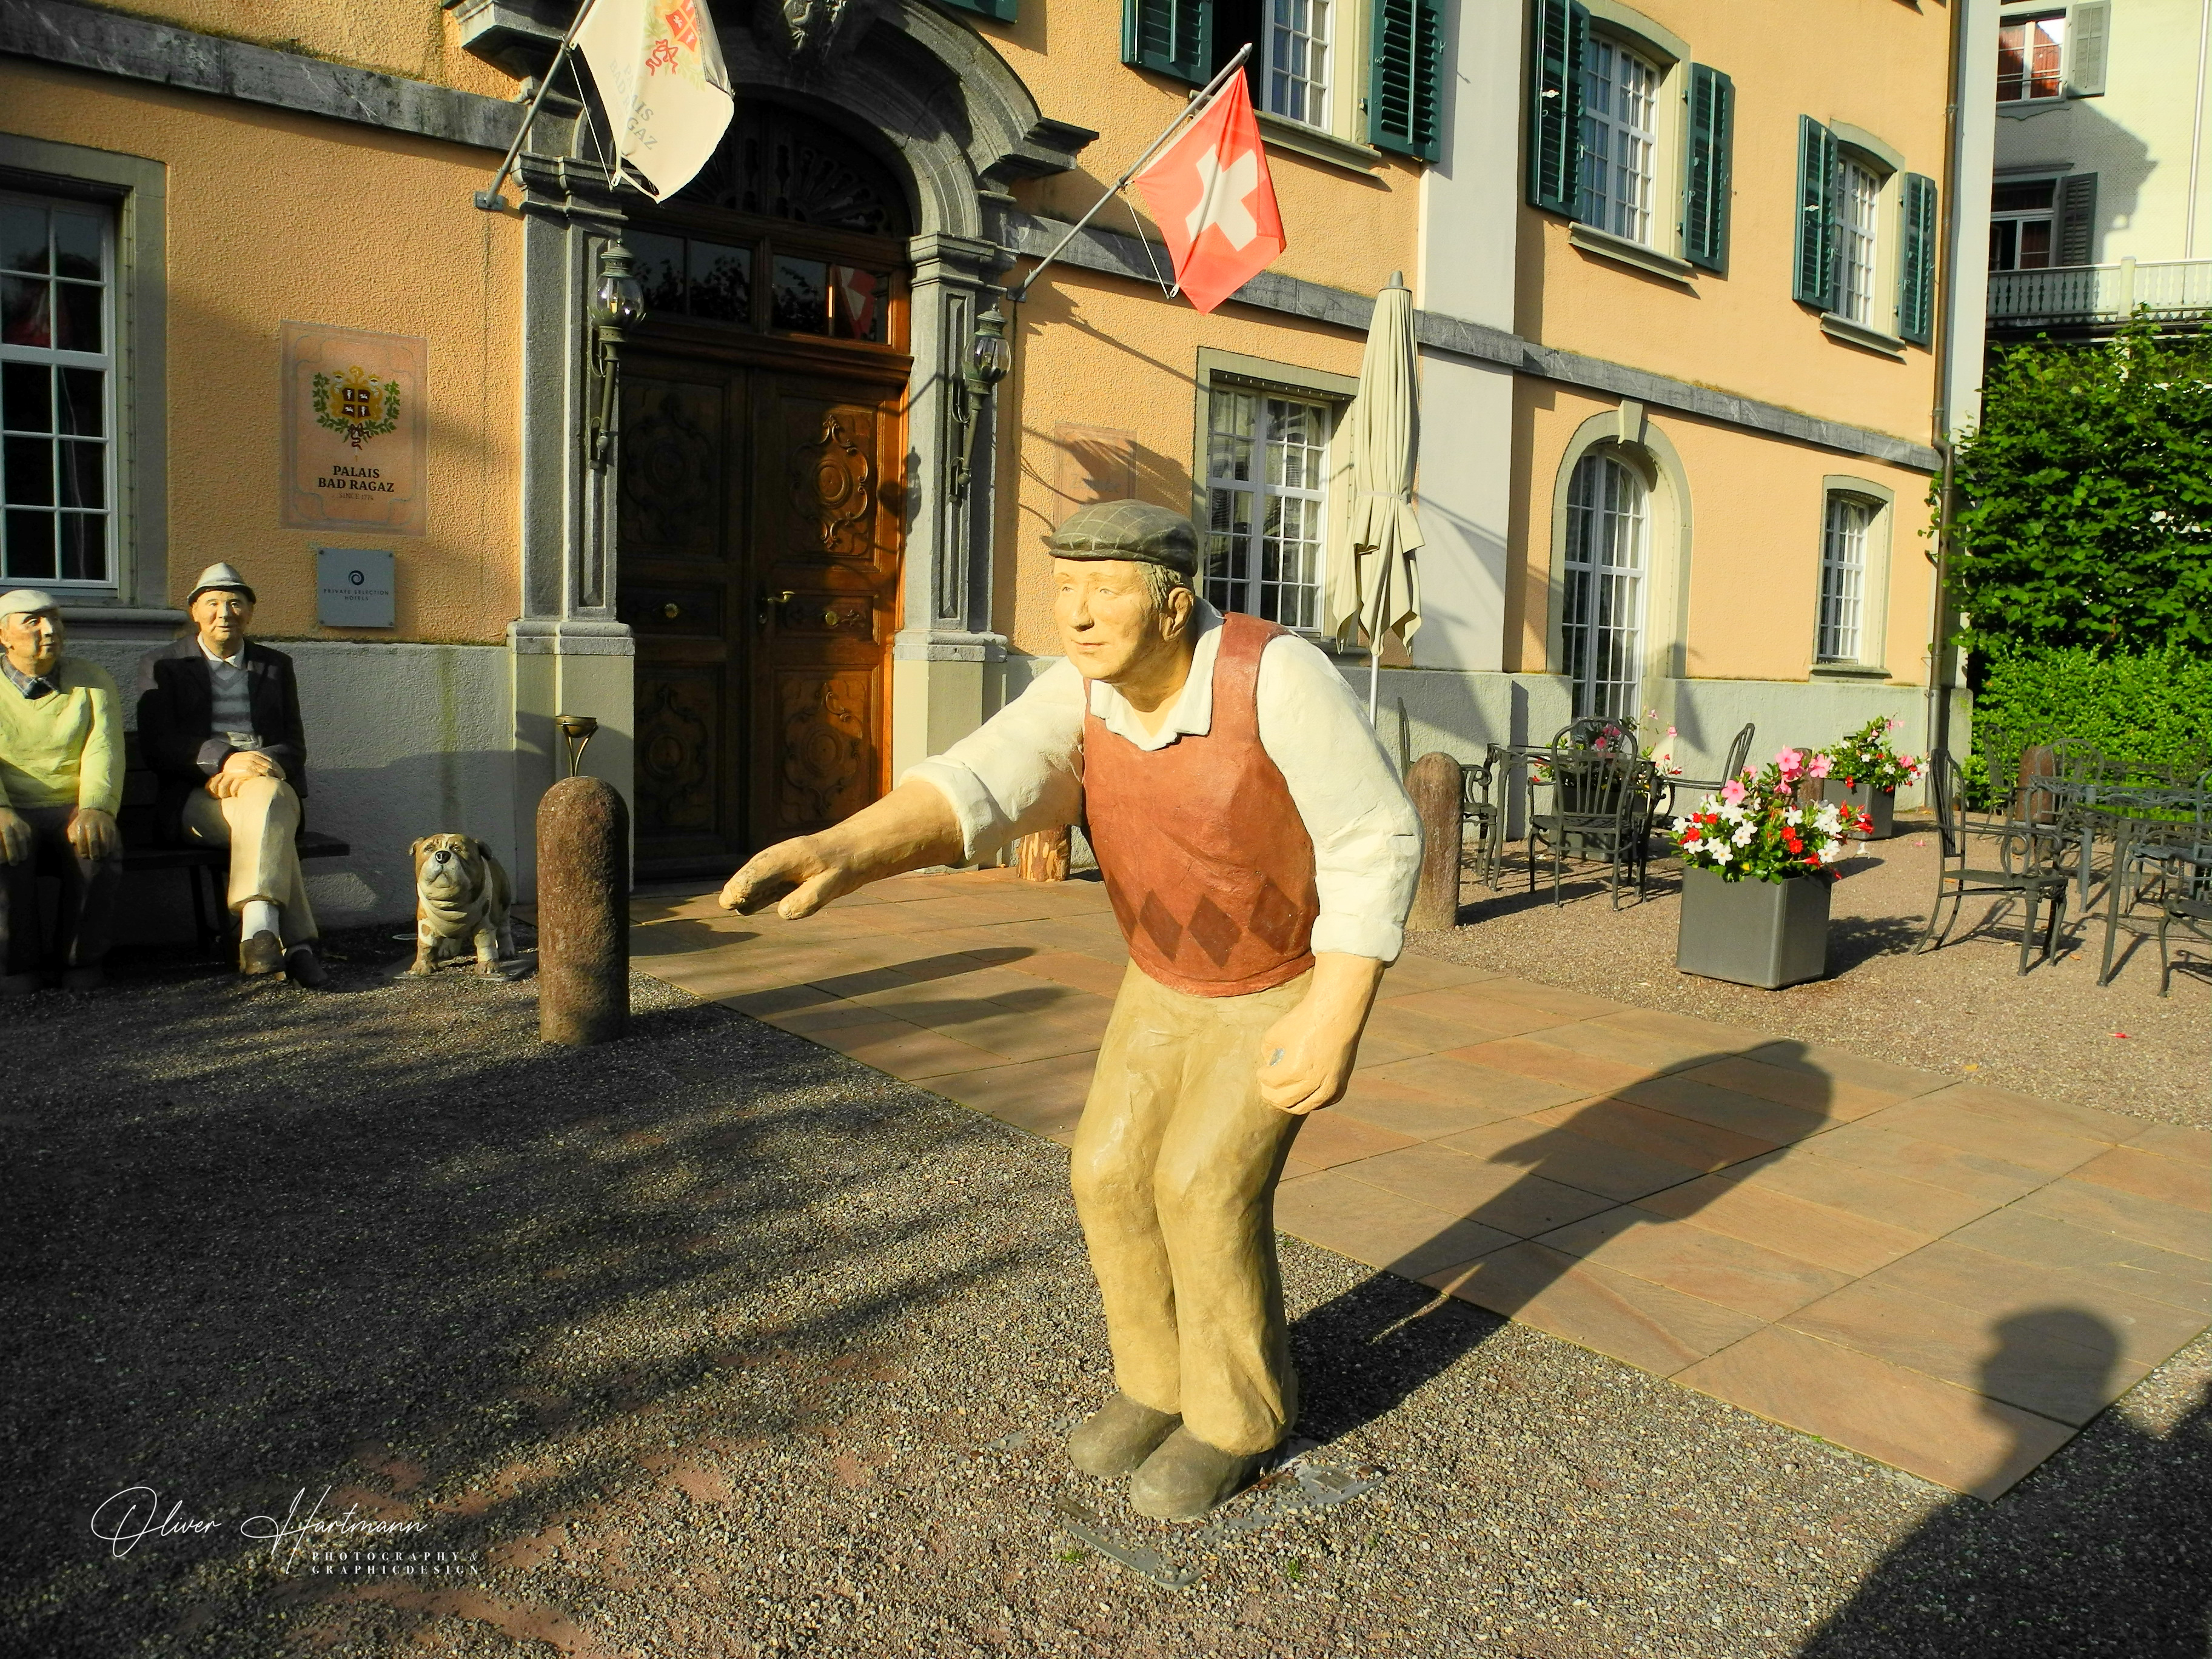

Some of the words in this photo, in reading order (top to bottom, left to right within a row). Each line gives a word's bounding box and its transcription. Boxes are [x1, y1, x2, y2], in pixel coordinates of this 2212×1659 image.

[609, 59, 626, 94] BAD
[332, 465, 380, 479] PALAIS
[318, 477, 346, 489] BAD
[350, 480, 395, 492] RAGAZ
